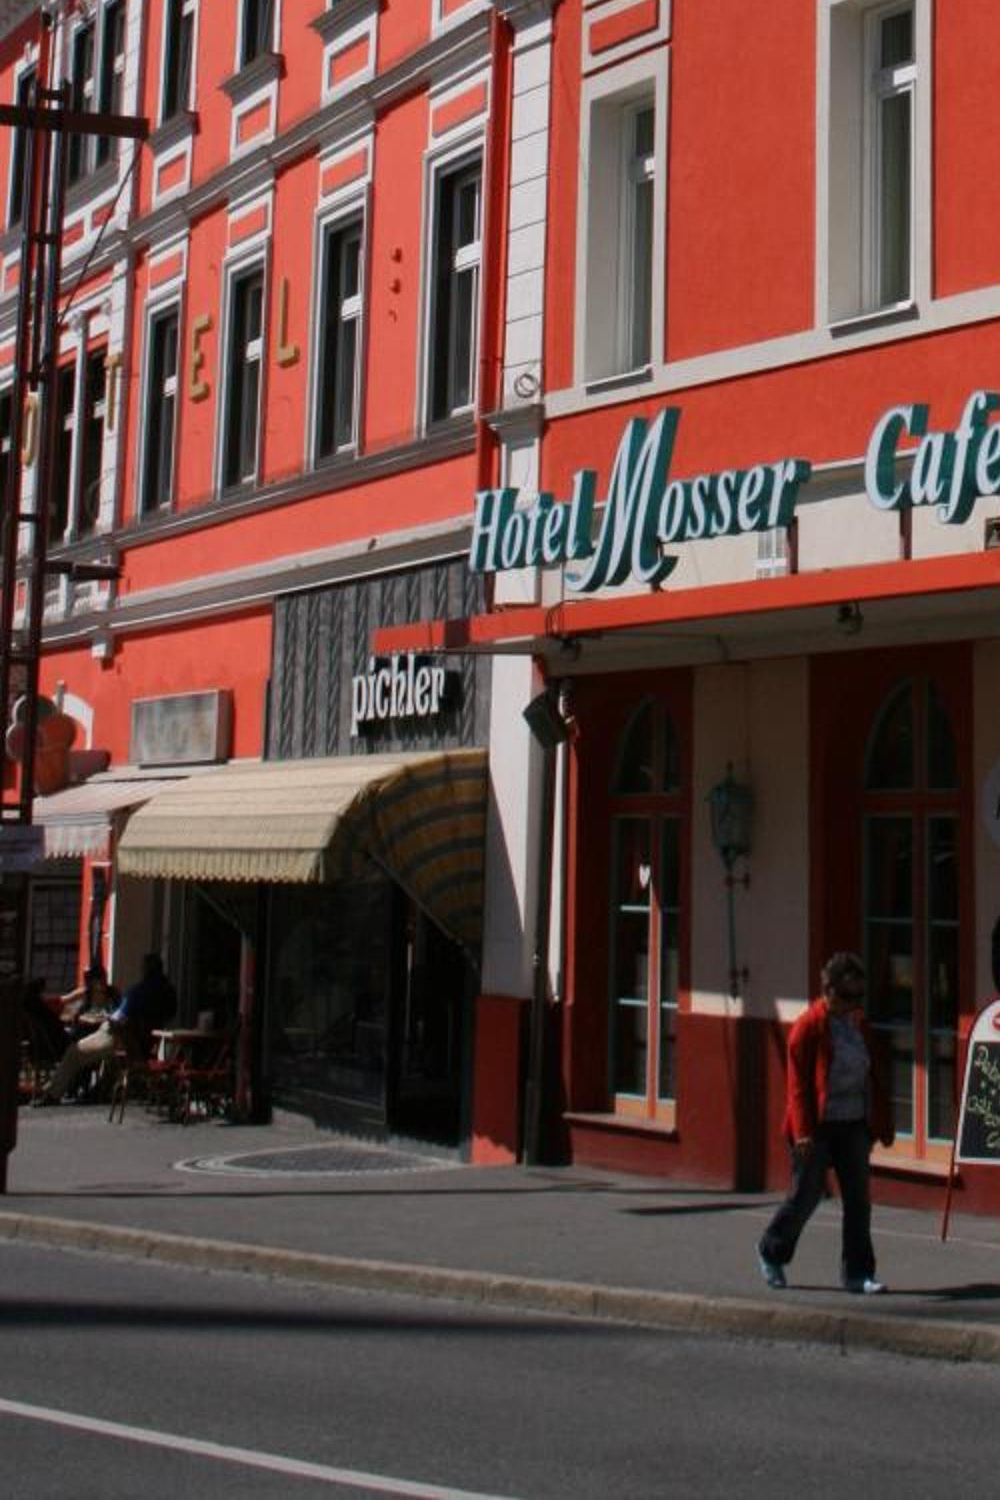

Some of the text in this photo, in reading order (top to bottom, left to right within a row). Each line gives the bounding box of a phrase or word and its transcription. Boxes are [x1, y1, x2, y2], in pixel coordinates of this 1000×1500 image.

[469, 468, 597, 572] Hotel
[564, 407, 811, 592] Mosser
[350, 653, 445, 737] pichler
